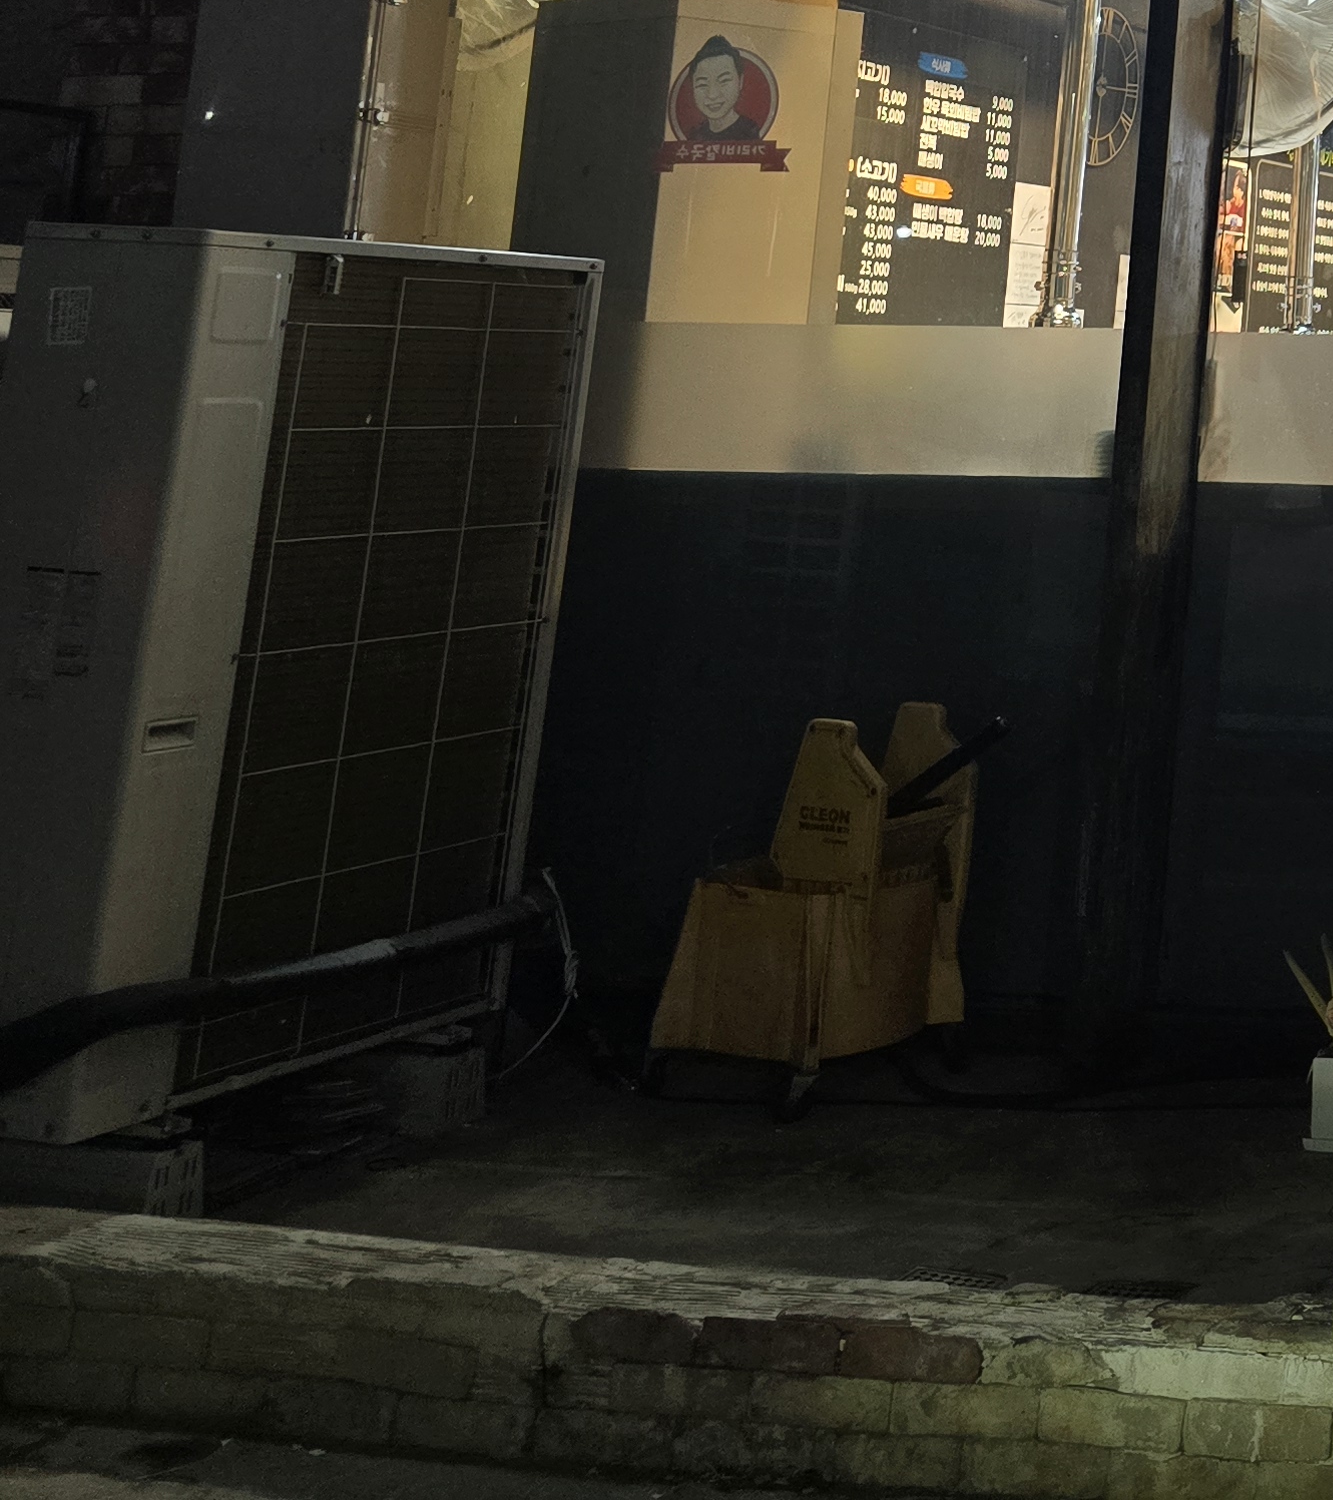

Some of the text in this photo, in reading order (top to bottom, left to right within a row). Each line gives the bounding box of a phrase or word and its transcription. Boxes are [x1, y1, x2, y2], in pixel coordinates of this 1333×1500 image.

[879, 87, 908, 107] 18,000
[991, 95, 1014, 112] 9,000
[876, 105, 906, 125] 15,000
[987, 111, 1013, 129] 11,000
[985, 128, 1011, 146] 11,000
[987, 146, 1010, 163] 5,000
[985, 162, 1008, 180] 5,000
[867, 185, 898, 204] 40,000
[865, 204, 896, 222] 43,000
[977, 214, 1003, 231] 18,000
[863, 223, 894, 241] 43,000
[974, 231, 1001, 248] 20,000
[861, 241, 892, 259] 45,000
[859, 260, 891, 278] 25,000
[858, 278, 889, 297] 28,000
[855, 297, 887, 316] 41,000
